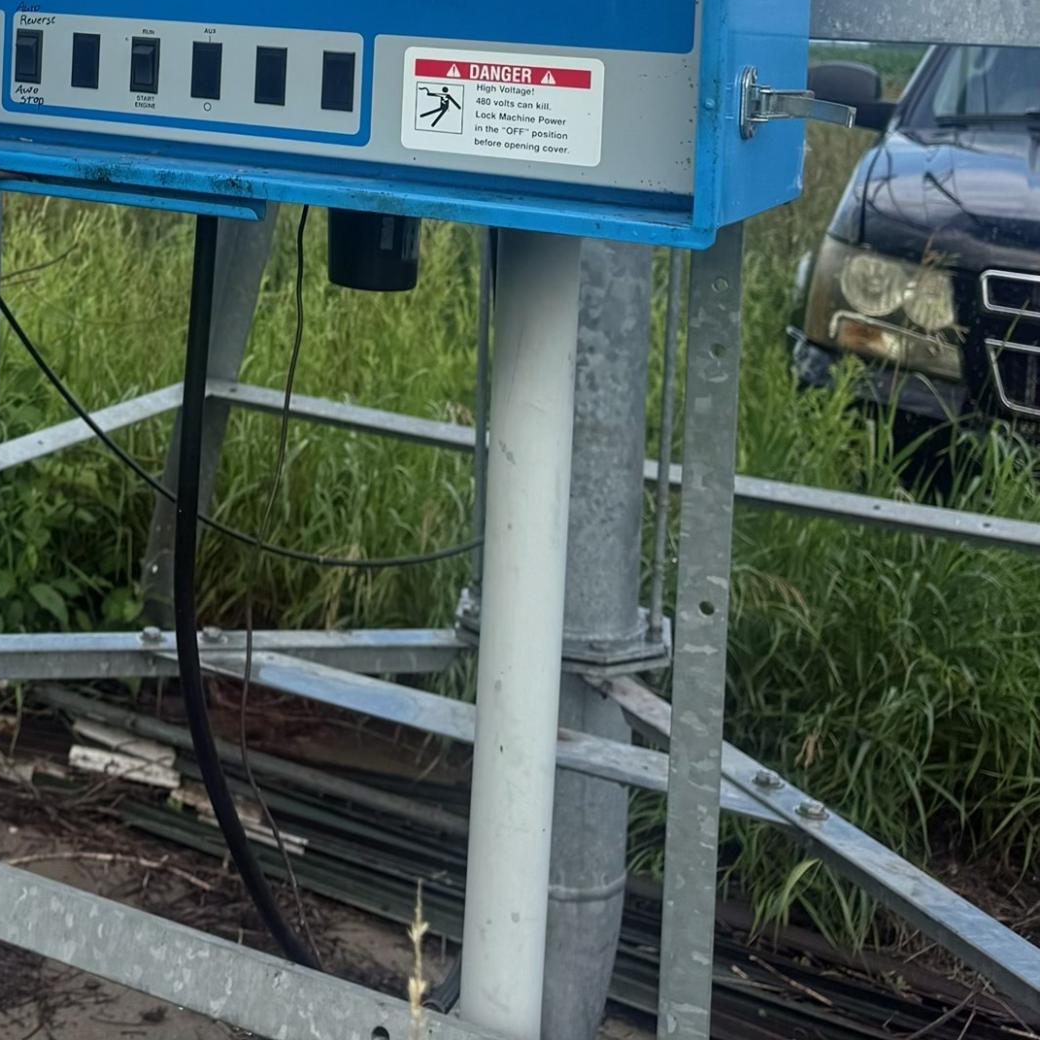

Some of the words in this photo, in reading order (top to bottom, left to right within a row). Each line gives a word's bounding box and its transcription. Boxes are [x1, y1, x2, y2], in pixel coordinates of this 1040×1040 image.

[469, 64, 532, 83] DANGER
[477, 85, 497, 94] High
[499, 86, 534, 96] Voltage!
[476, 97, 491, 106] 480
[494, 99, 515, 108] volts
[536, 101, 551, 110] kill.
[475, 111, 496, 120] Lock
[499, 113, 535, 124] Machine
[538, 116, 566, 125] Power
[485, 125, 499, 134] the
[531, 129, 568, 140] position
[474, 138, 501, 148] before
[504, 142, 540, 152] opening
[542, 145, 570, 154] cover.
